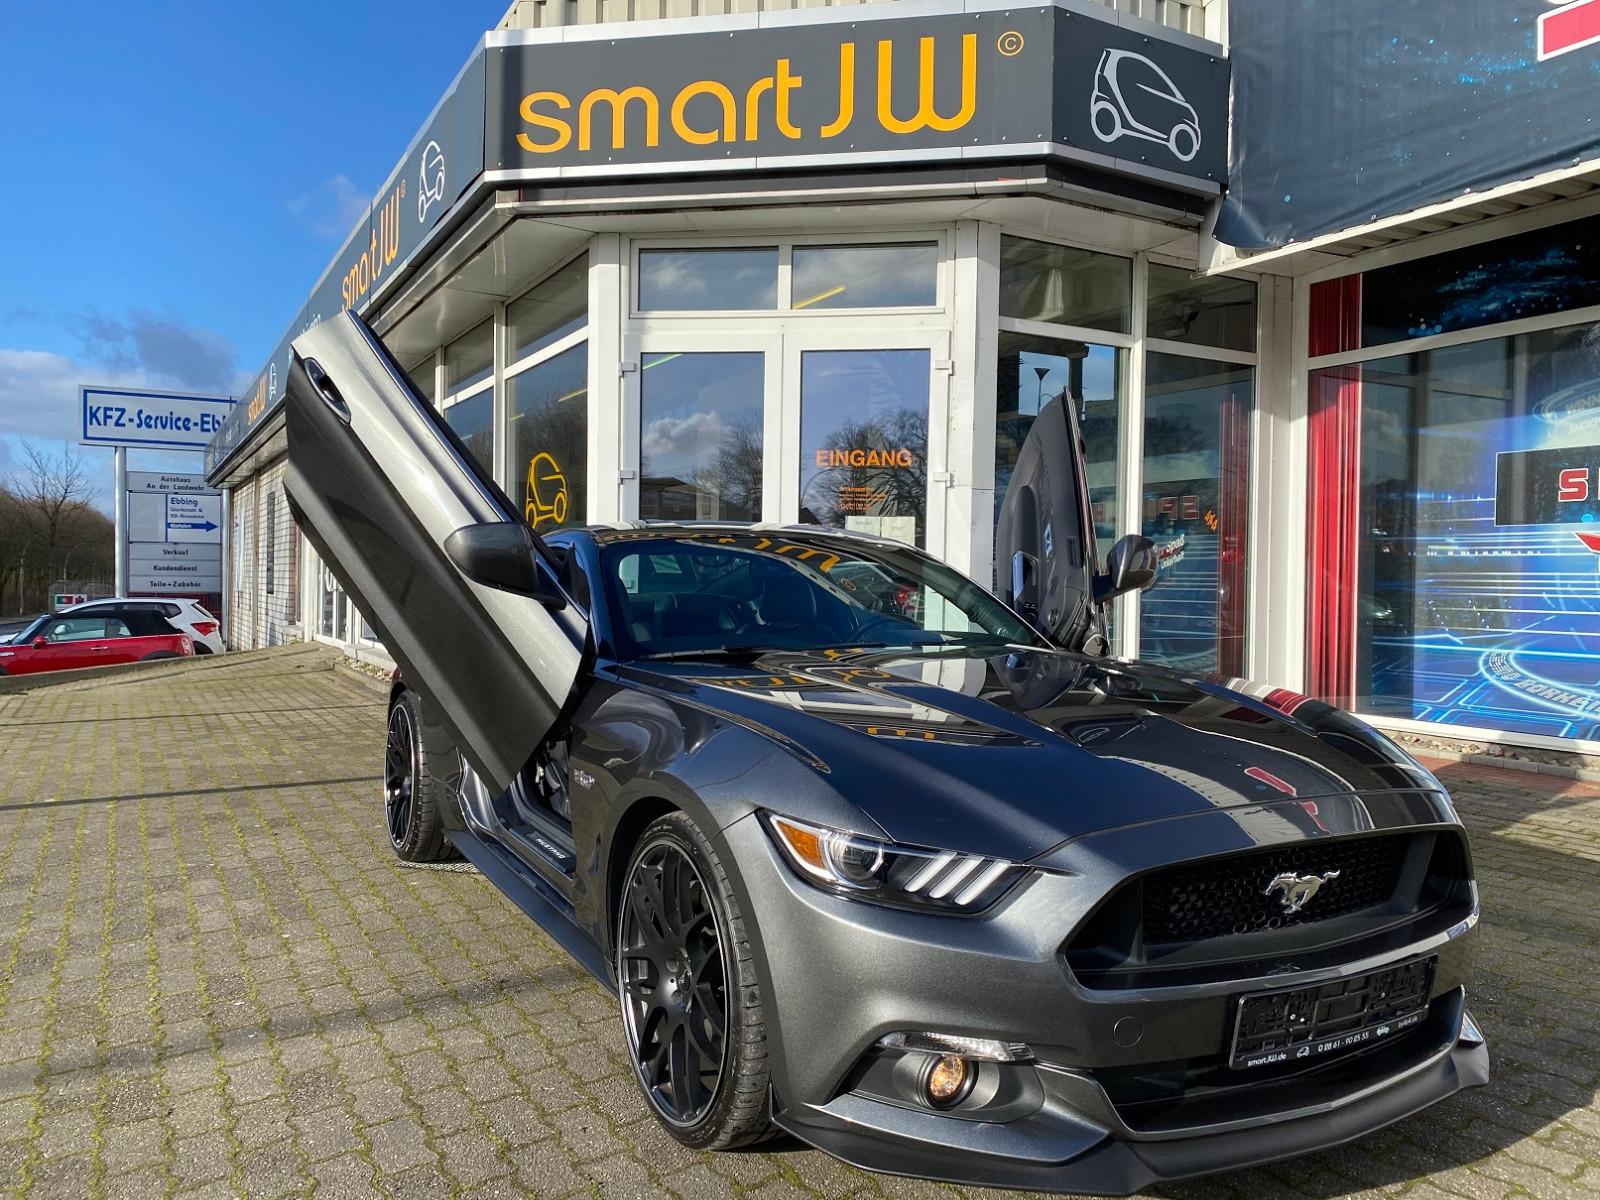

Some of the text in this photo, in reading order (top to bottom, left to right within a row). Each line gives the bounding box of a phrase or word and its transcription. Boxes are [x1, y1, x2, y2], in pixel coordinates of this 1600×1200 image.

[88, 405, 226, 433] KFZ-Service-Eb
[816, 448, 912, 467] EINGANG
[171, 497, 198, 507] Ebbing
[163, 548, 189, 556] Verkauf
